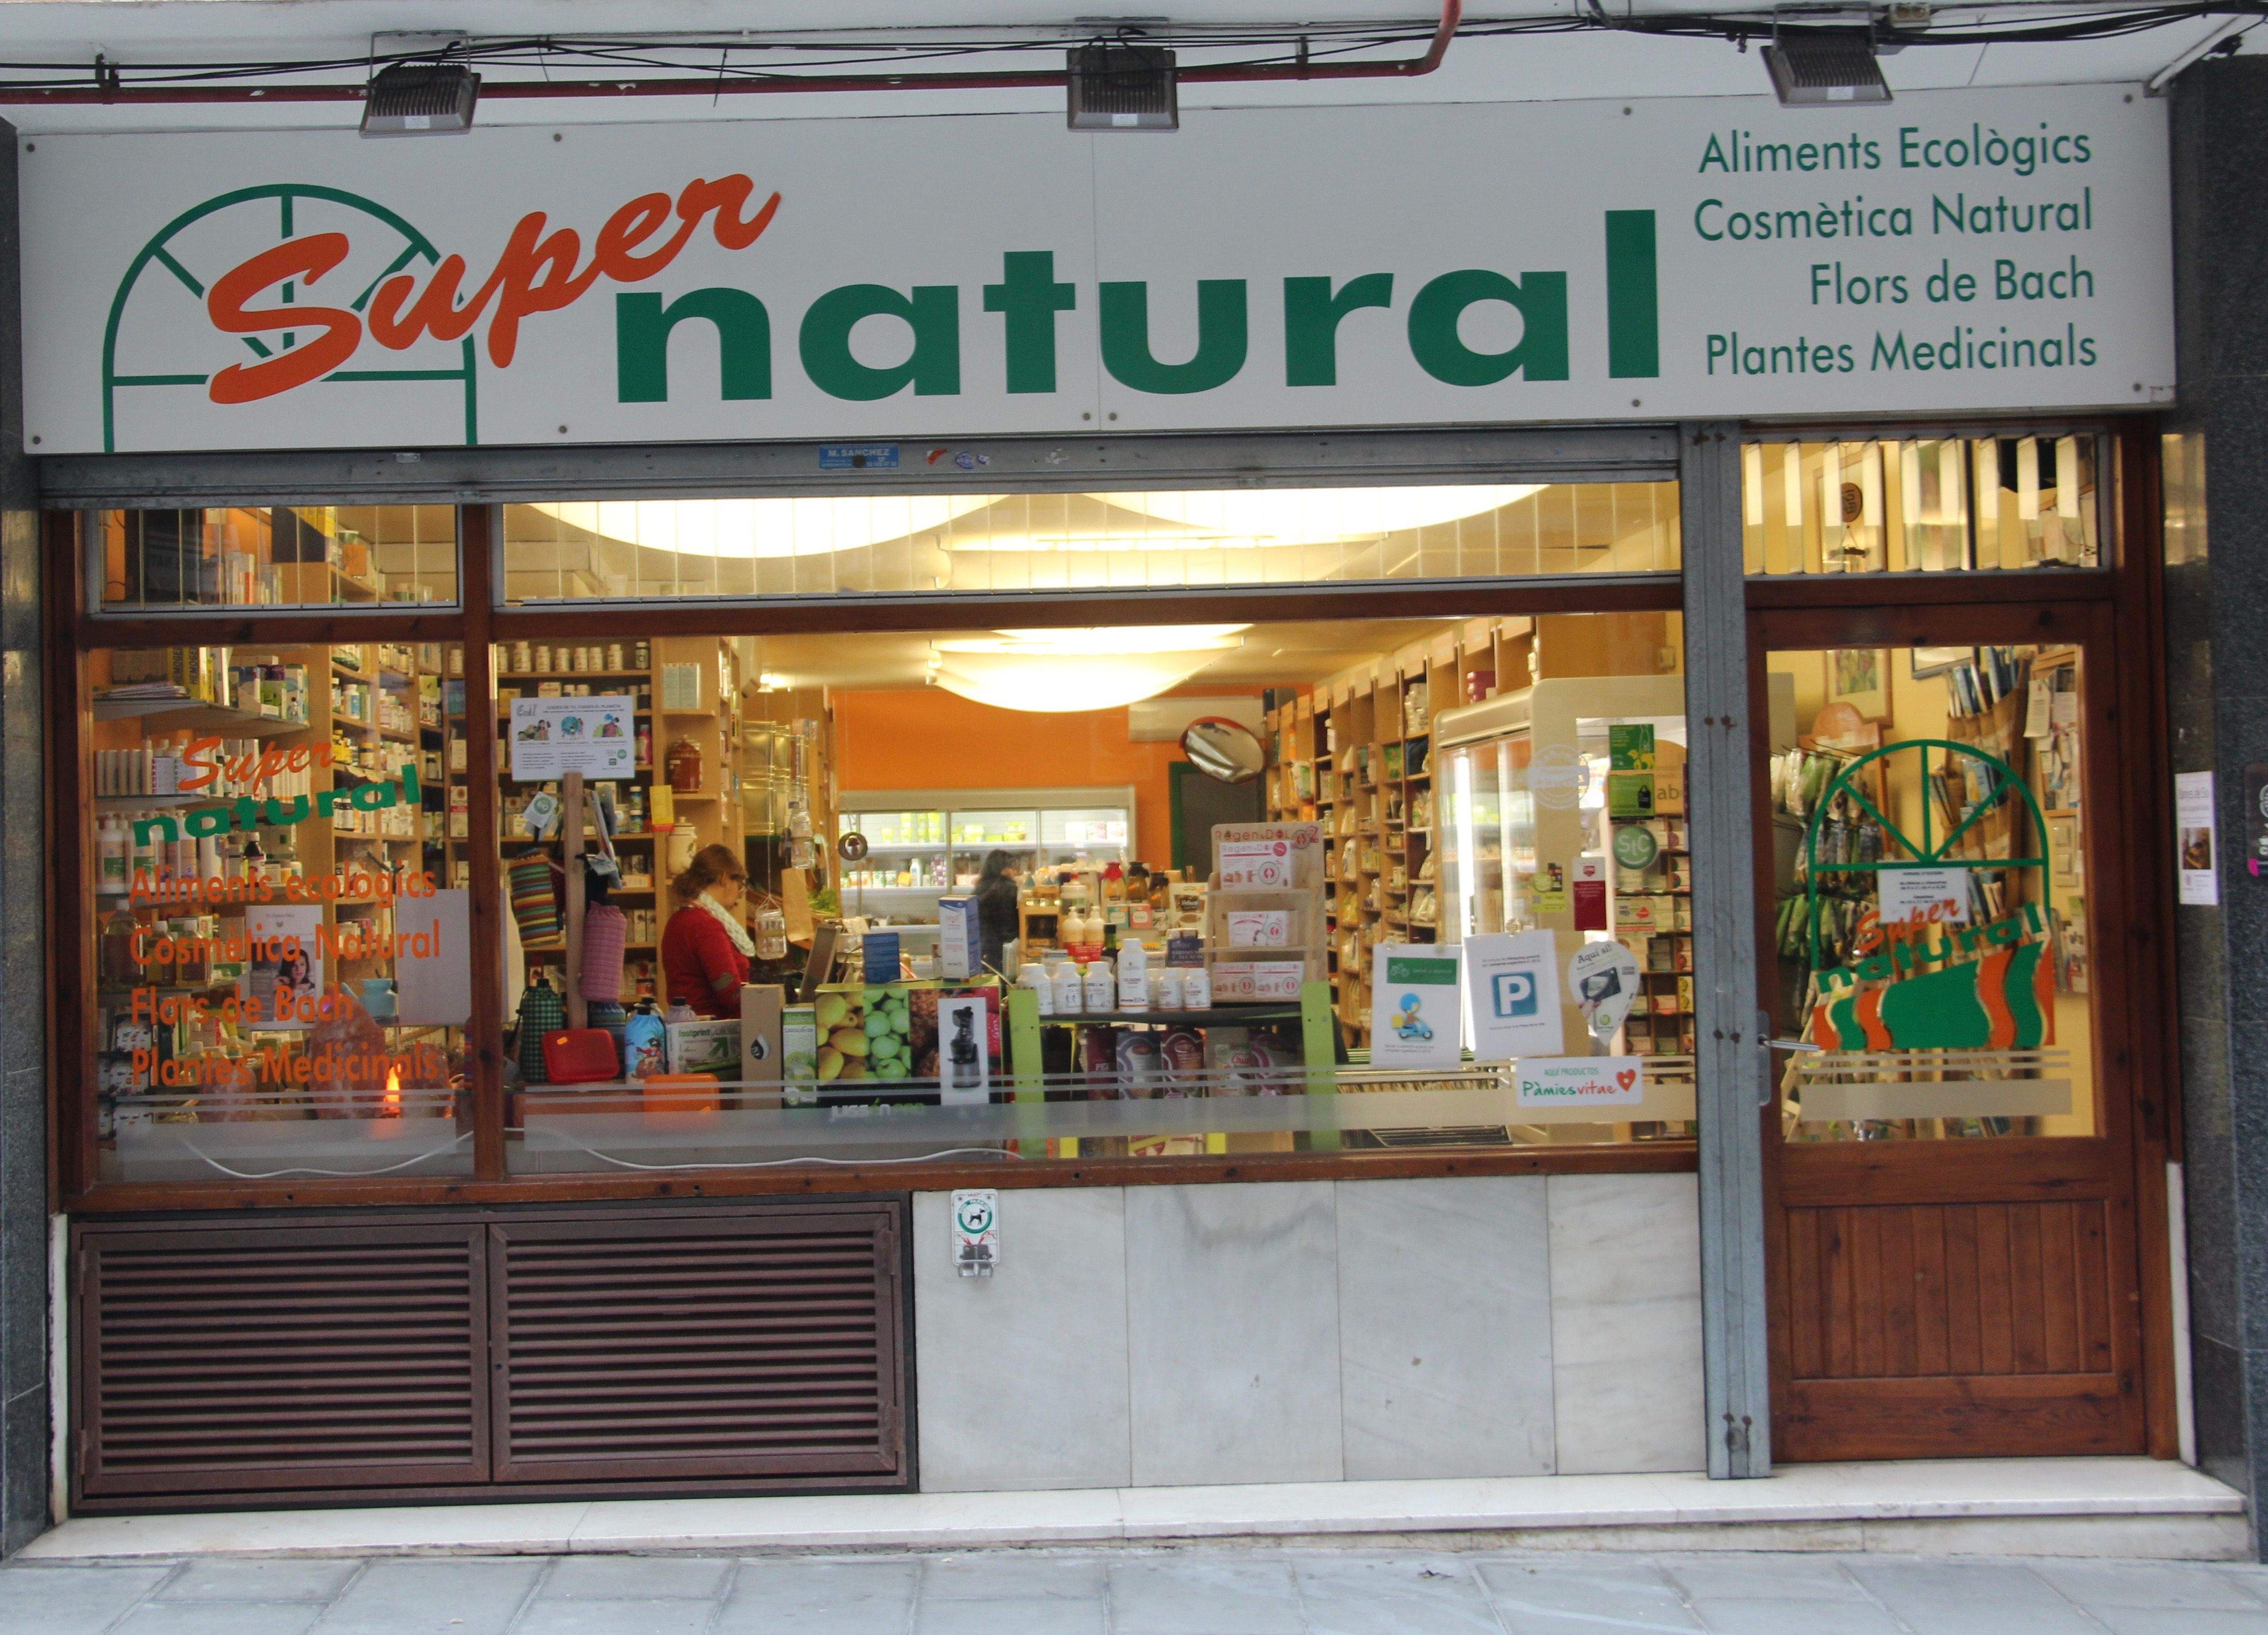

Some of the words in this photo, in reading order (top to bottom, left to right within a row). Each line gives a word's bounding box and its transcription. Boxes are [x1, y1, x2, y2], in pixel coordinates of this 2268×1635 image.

[1699, 129, 1881, 173] Aliments
[1901, 123, 2090, 176] Ecològics
[1696, 197, 1911, 240] Cosmètica
[1934, 188, 2090, 233] Natural
[209, 174, 780, 403] Super
[617, 210, 1659, 402] natural
[1813, 263, 1907, 304] Flors
[1927, 259, 1975, 302] de
[1996, 256, 2093, 299] Bach
[1709, 332, 1853, 374] Plantes
[1872, 323, 2096, 370] Medicinals
[177, 736, 336, 792] Super
[133, 764, 422, 847] natural
[129, 865, 272, 903] Aliments
[284, 860, 437, 908] ecològics
[130, 923, 301, 965] Cosmètica
[315, 919, 440, 960] Natural
[1817, 903, 2042, 994] natural
[1856, 896, 1961, 953] Super
[131, 987, 210, 1026] Flors
[222, 983, 262, 1023] de
[276, 981, 354, 1022] Bach
[132, 1046, 249, 1086] Plantes
[262, 1040, 439, 1083] Medicinals
